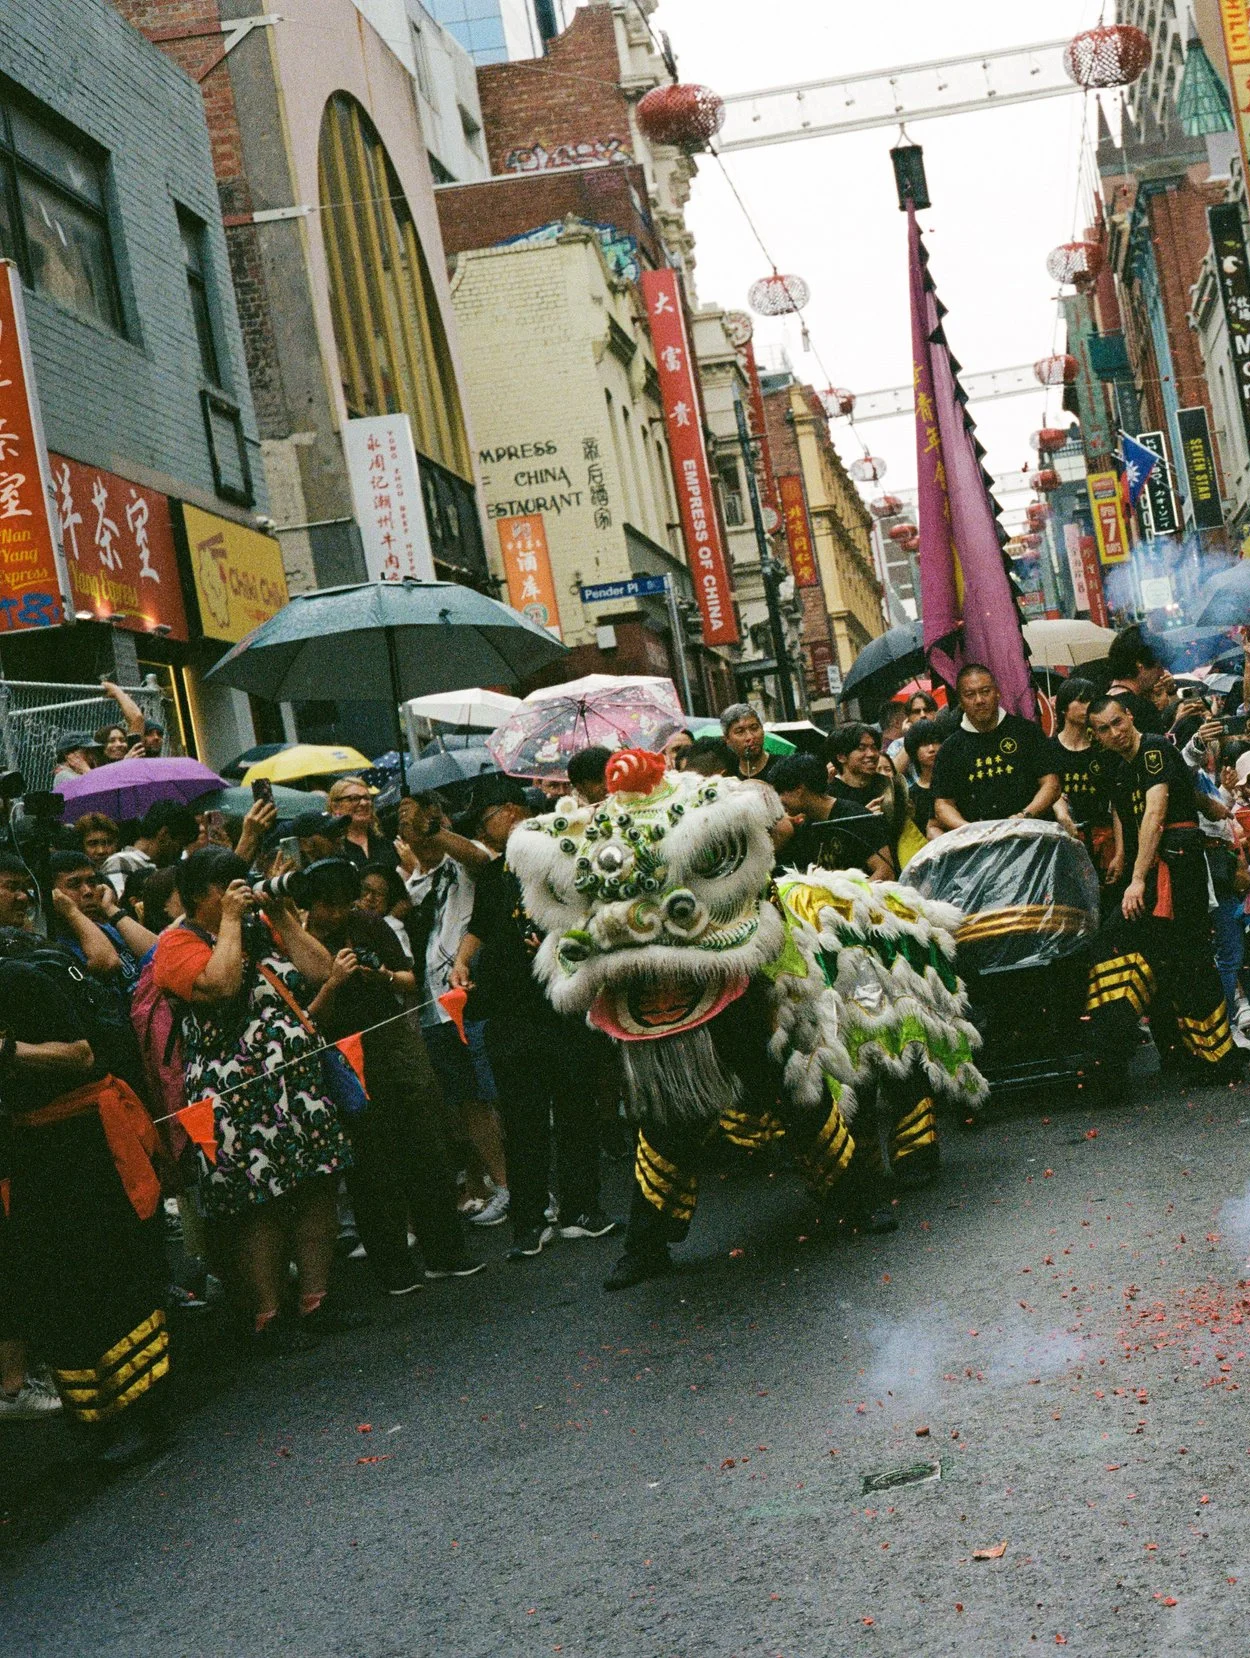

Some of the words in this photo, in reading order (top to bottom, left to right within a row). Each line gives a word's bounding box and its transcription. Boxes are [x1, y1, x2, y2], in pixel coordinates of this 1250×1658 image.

[1189, 438, 1205, 471] SEVEN
[514, 466, 573, 488] CHINA
[682, 459, 709, 542] EMPRESS
[1102, 518, 1116, 542] 7
[2, 548, 38, 564] Yang
[698, 546, 714, 571] OF
[584, 586, 624, 600] Pender
[627, 579, 639, 593] Pl
[703, 574, 725, 632] CHINA
